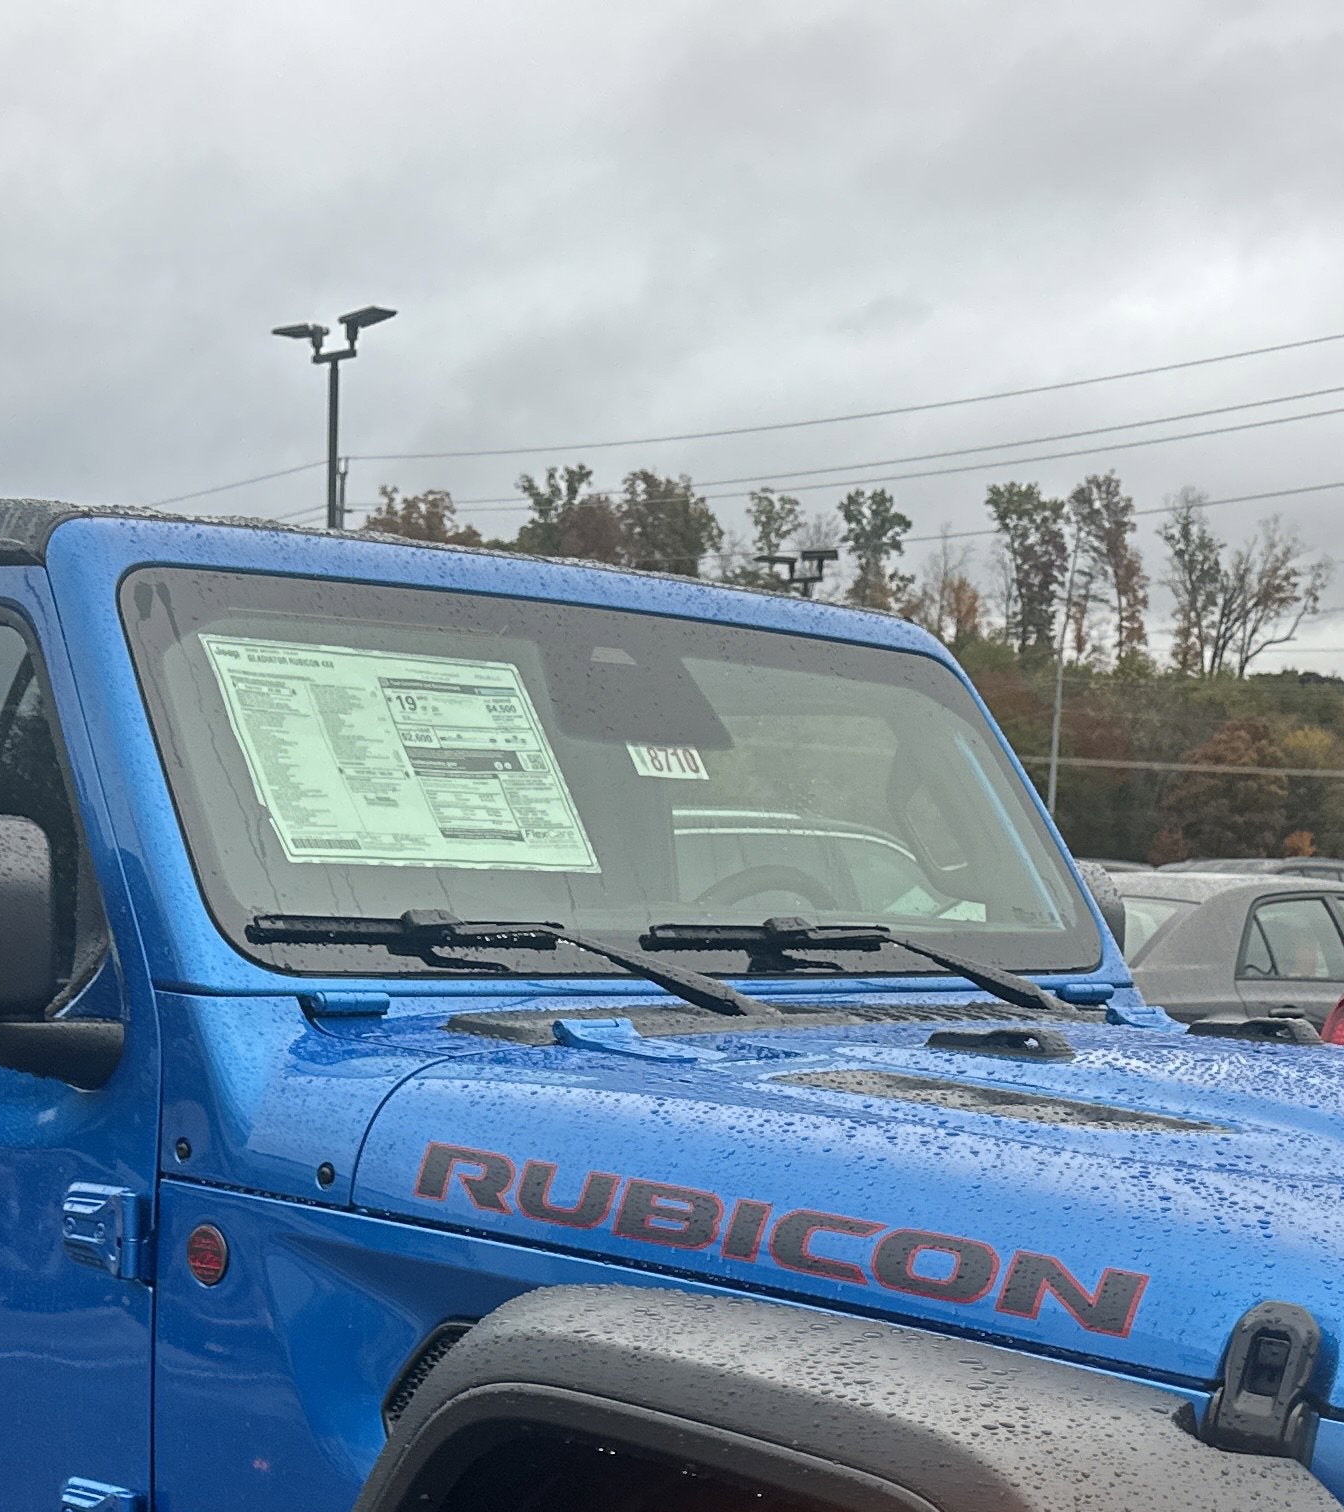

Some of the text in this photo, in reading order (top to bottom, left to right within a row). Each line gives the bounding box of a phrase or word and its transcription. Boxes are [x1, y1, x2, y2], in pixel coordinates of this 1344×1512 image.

[396, 695, 418, 712] 19
[647, 746, 700, 774] 8710
[413, 1141, 1151, 1339] RUBICON
